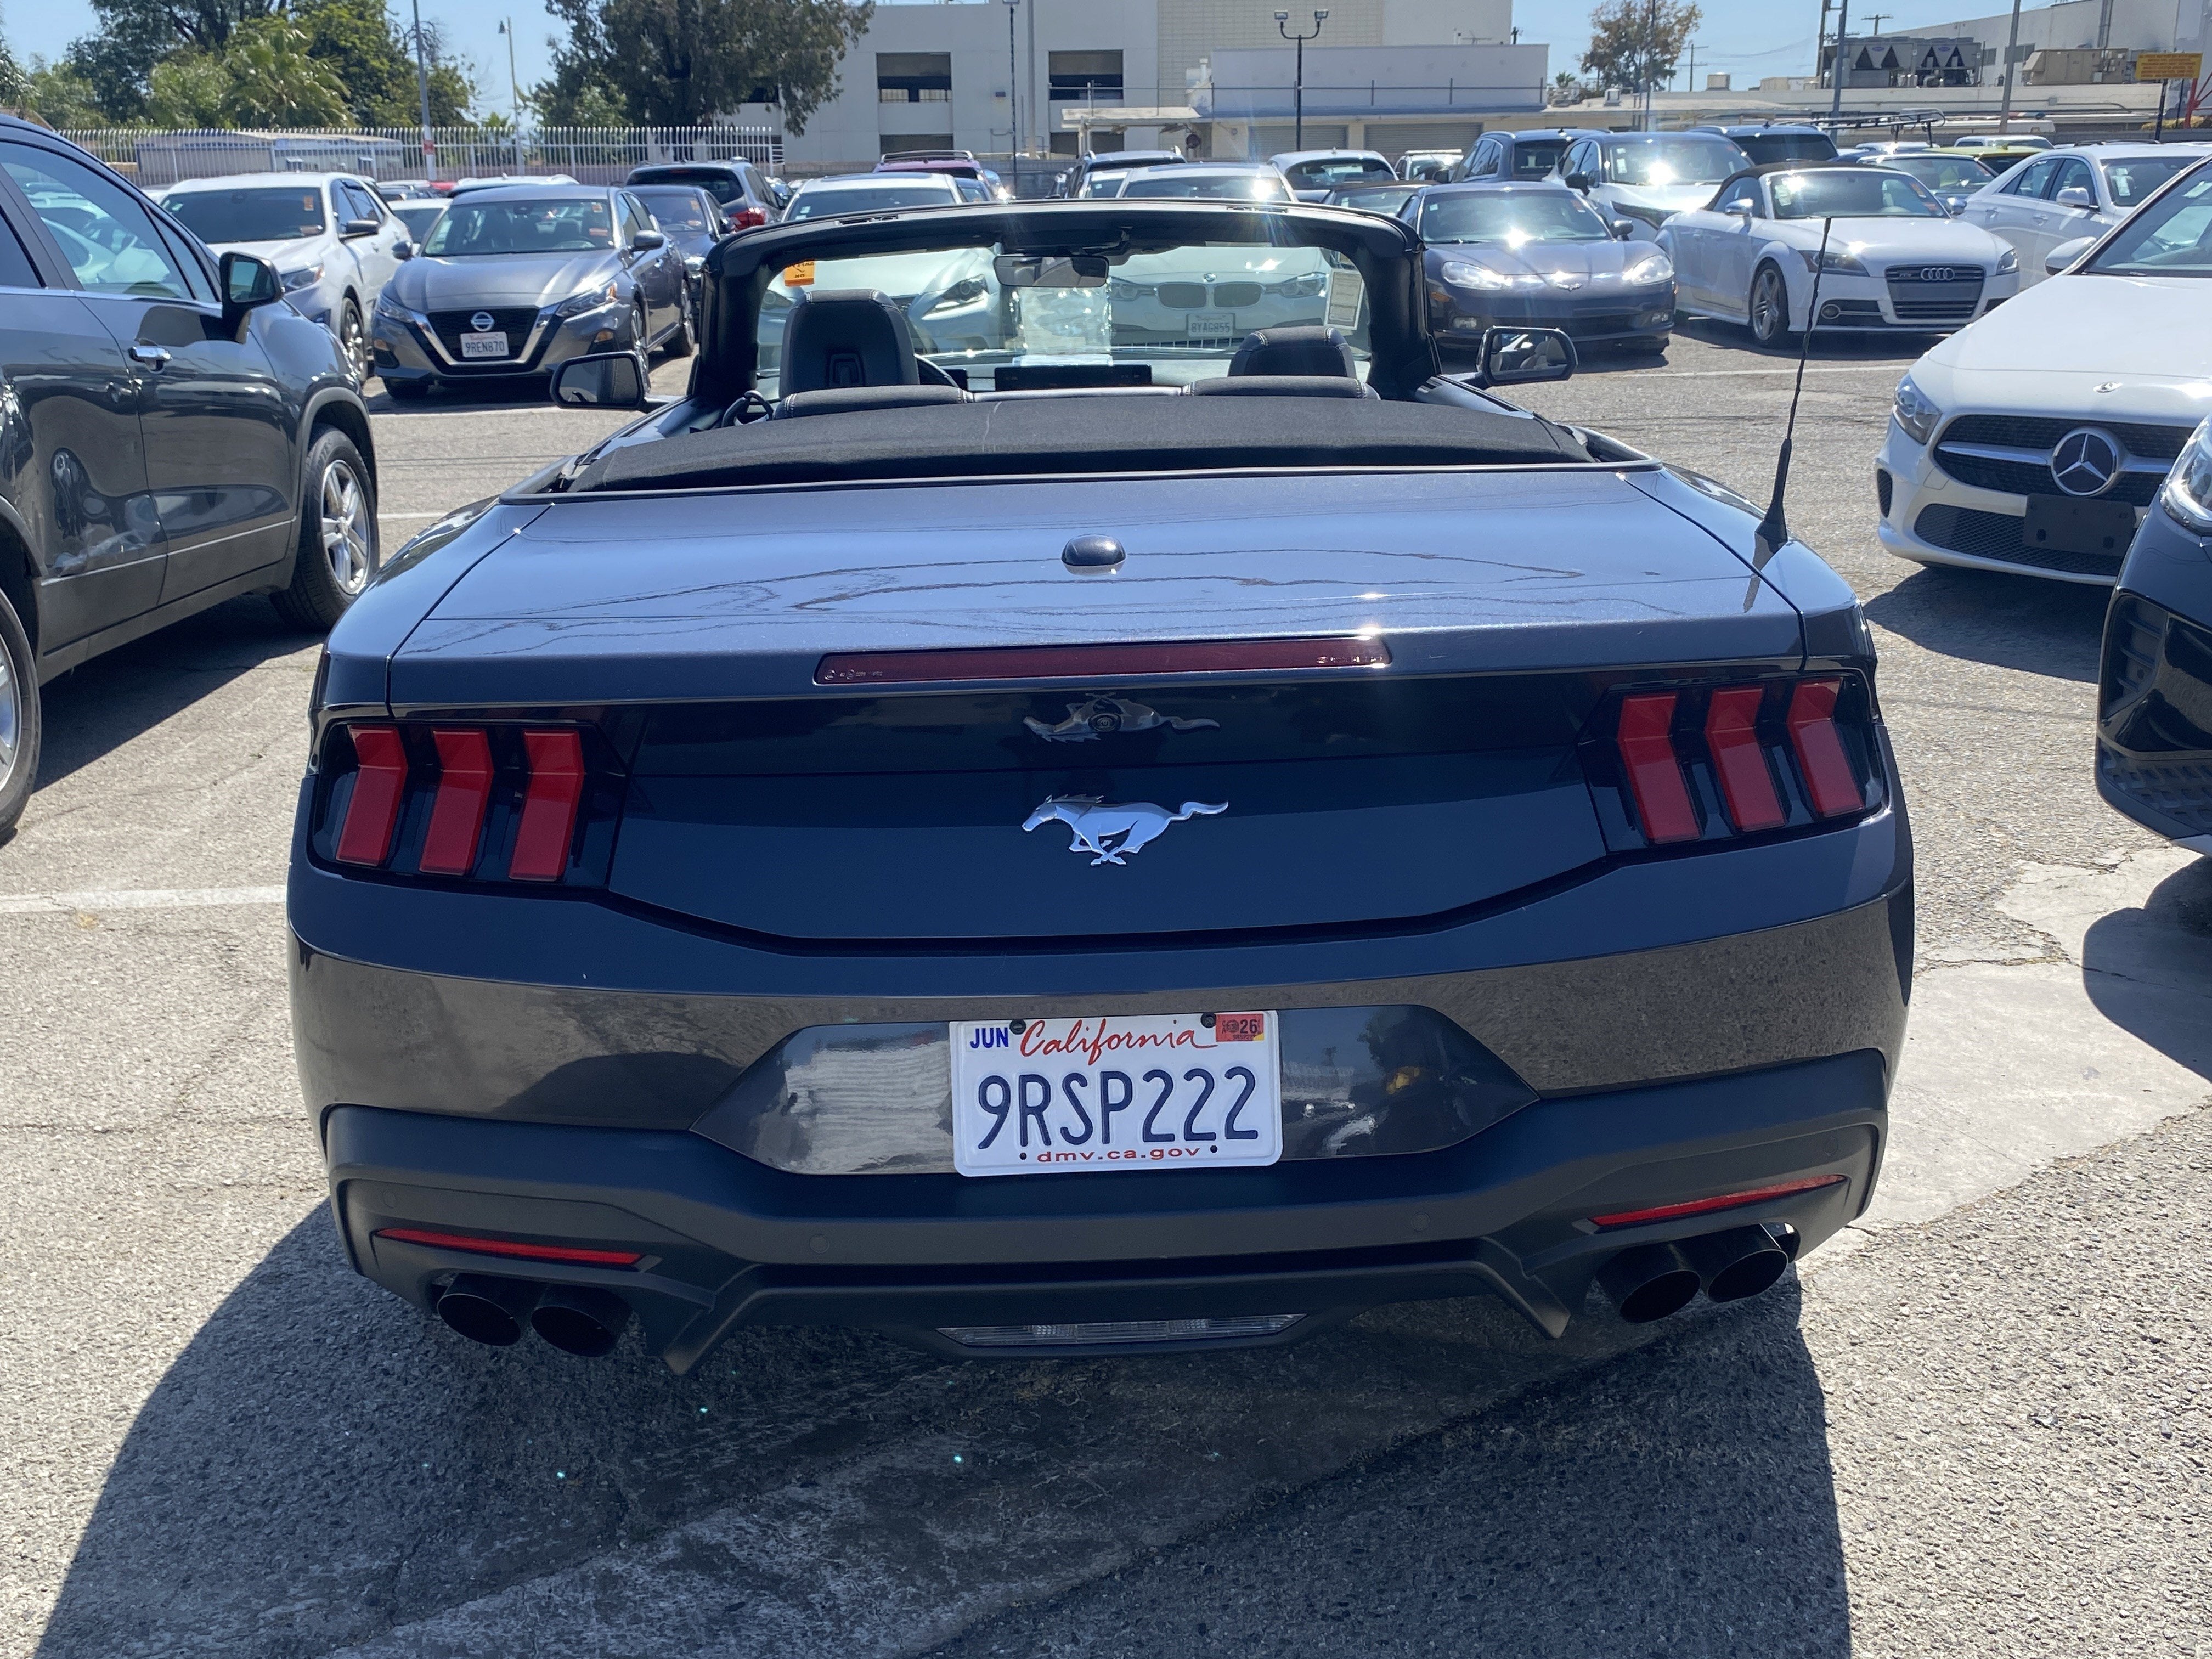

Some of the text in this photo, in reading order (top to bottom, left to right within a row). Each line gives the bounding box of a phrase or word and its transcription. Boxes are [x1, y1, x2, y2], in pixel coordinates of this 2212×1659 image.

[466, 341, 504, 353] 9REN870
[1240, 1019, 1257, 1034] 26
[969, 1027, 1009, 1049] JUN
[1020, 1018, 1218, 1065] California
[978, 1066, 1259, 1149] 9RSP222
[1037, 1147, 1200, 1163] dmv.ca.gov
